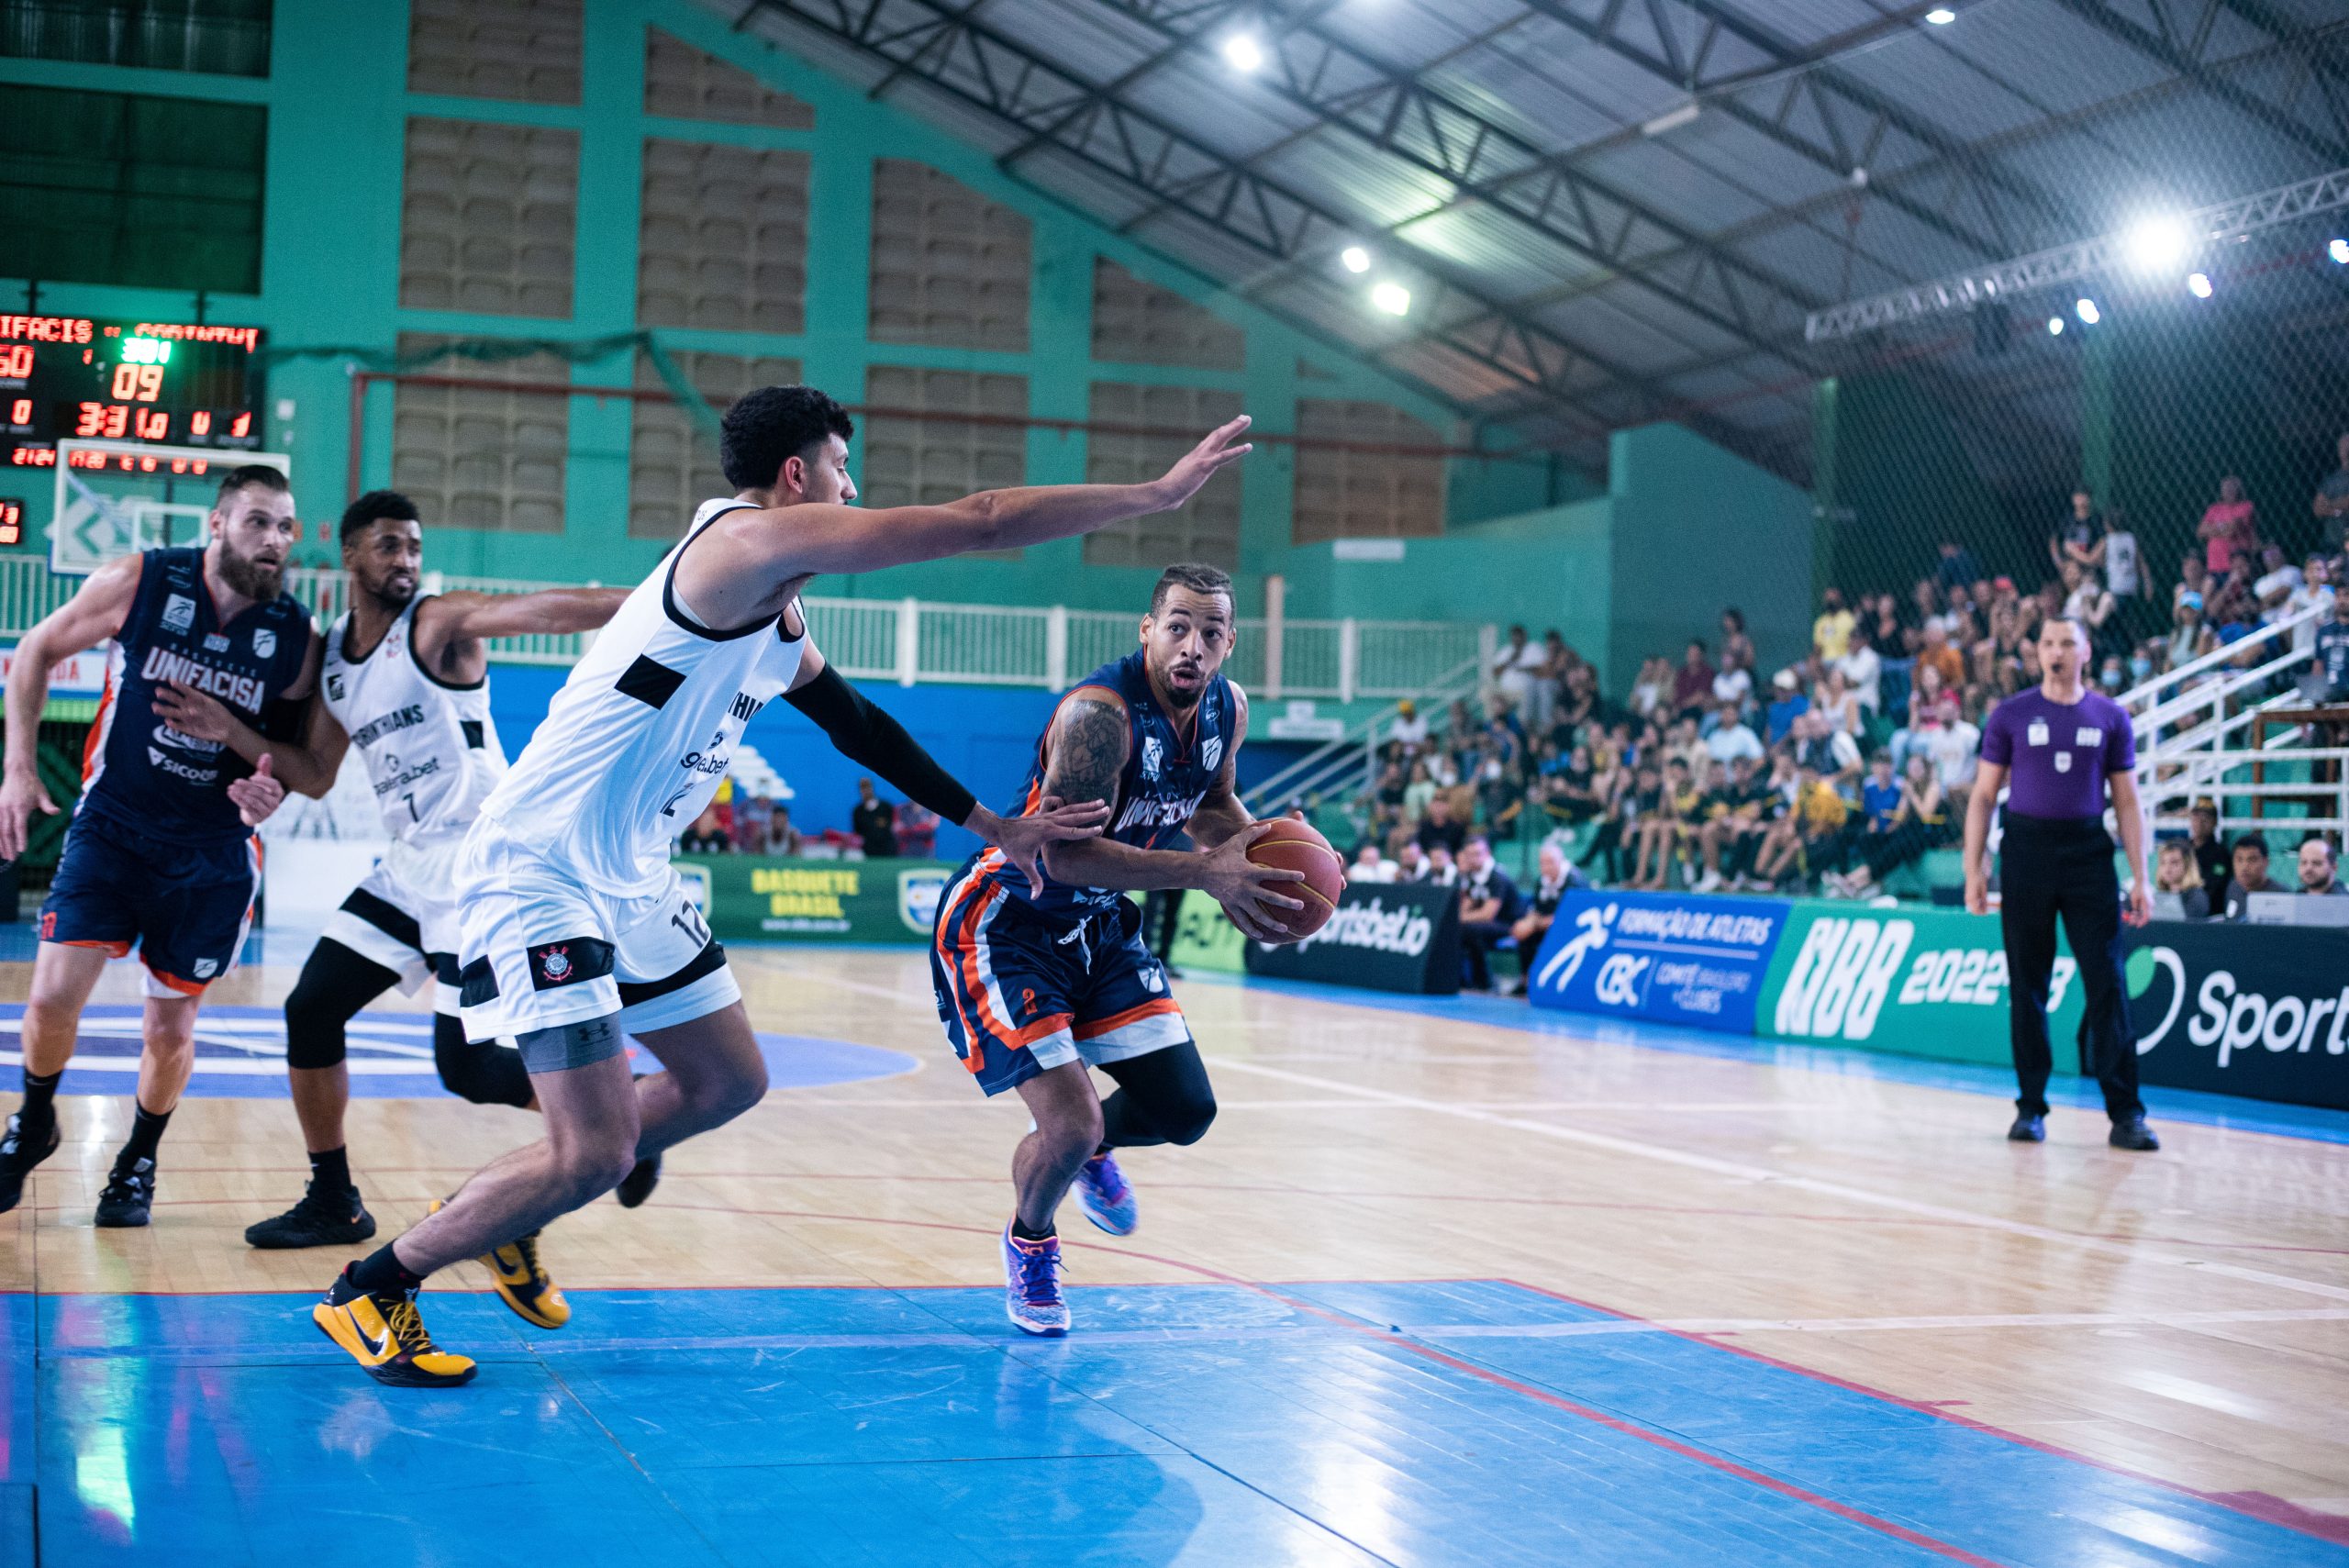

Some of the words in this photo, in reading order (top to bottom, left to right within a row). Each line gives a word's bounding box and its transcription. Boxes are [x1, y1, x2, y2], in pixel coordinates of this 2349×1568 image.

[112, 363, 164, 402] 09
[141, 645, 265, 715] UNIFACISA
[402, 793, 419, 823] 7
[671, 899, 711, 949] 12
[1022, 987, 1038, 1016] 2
